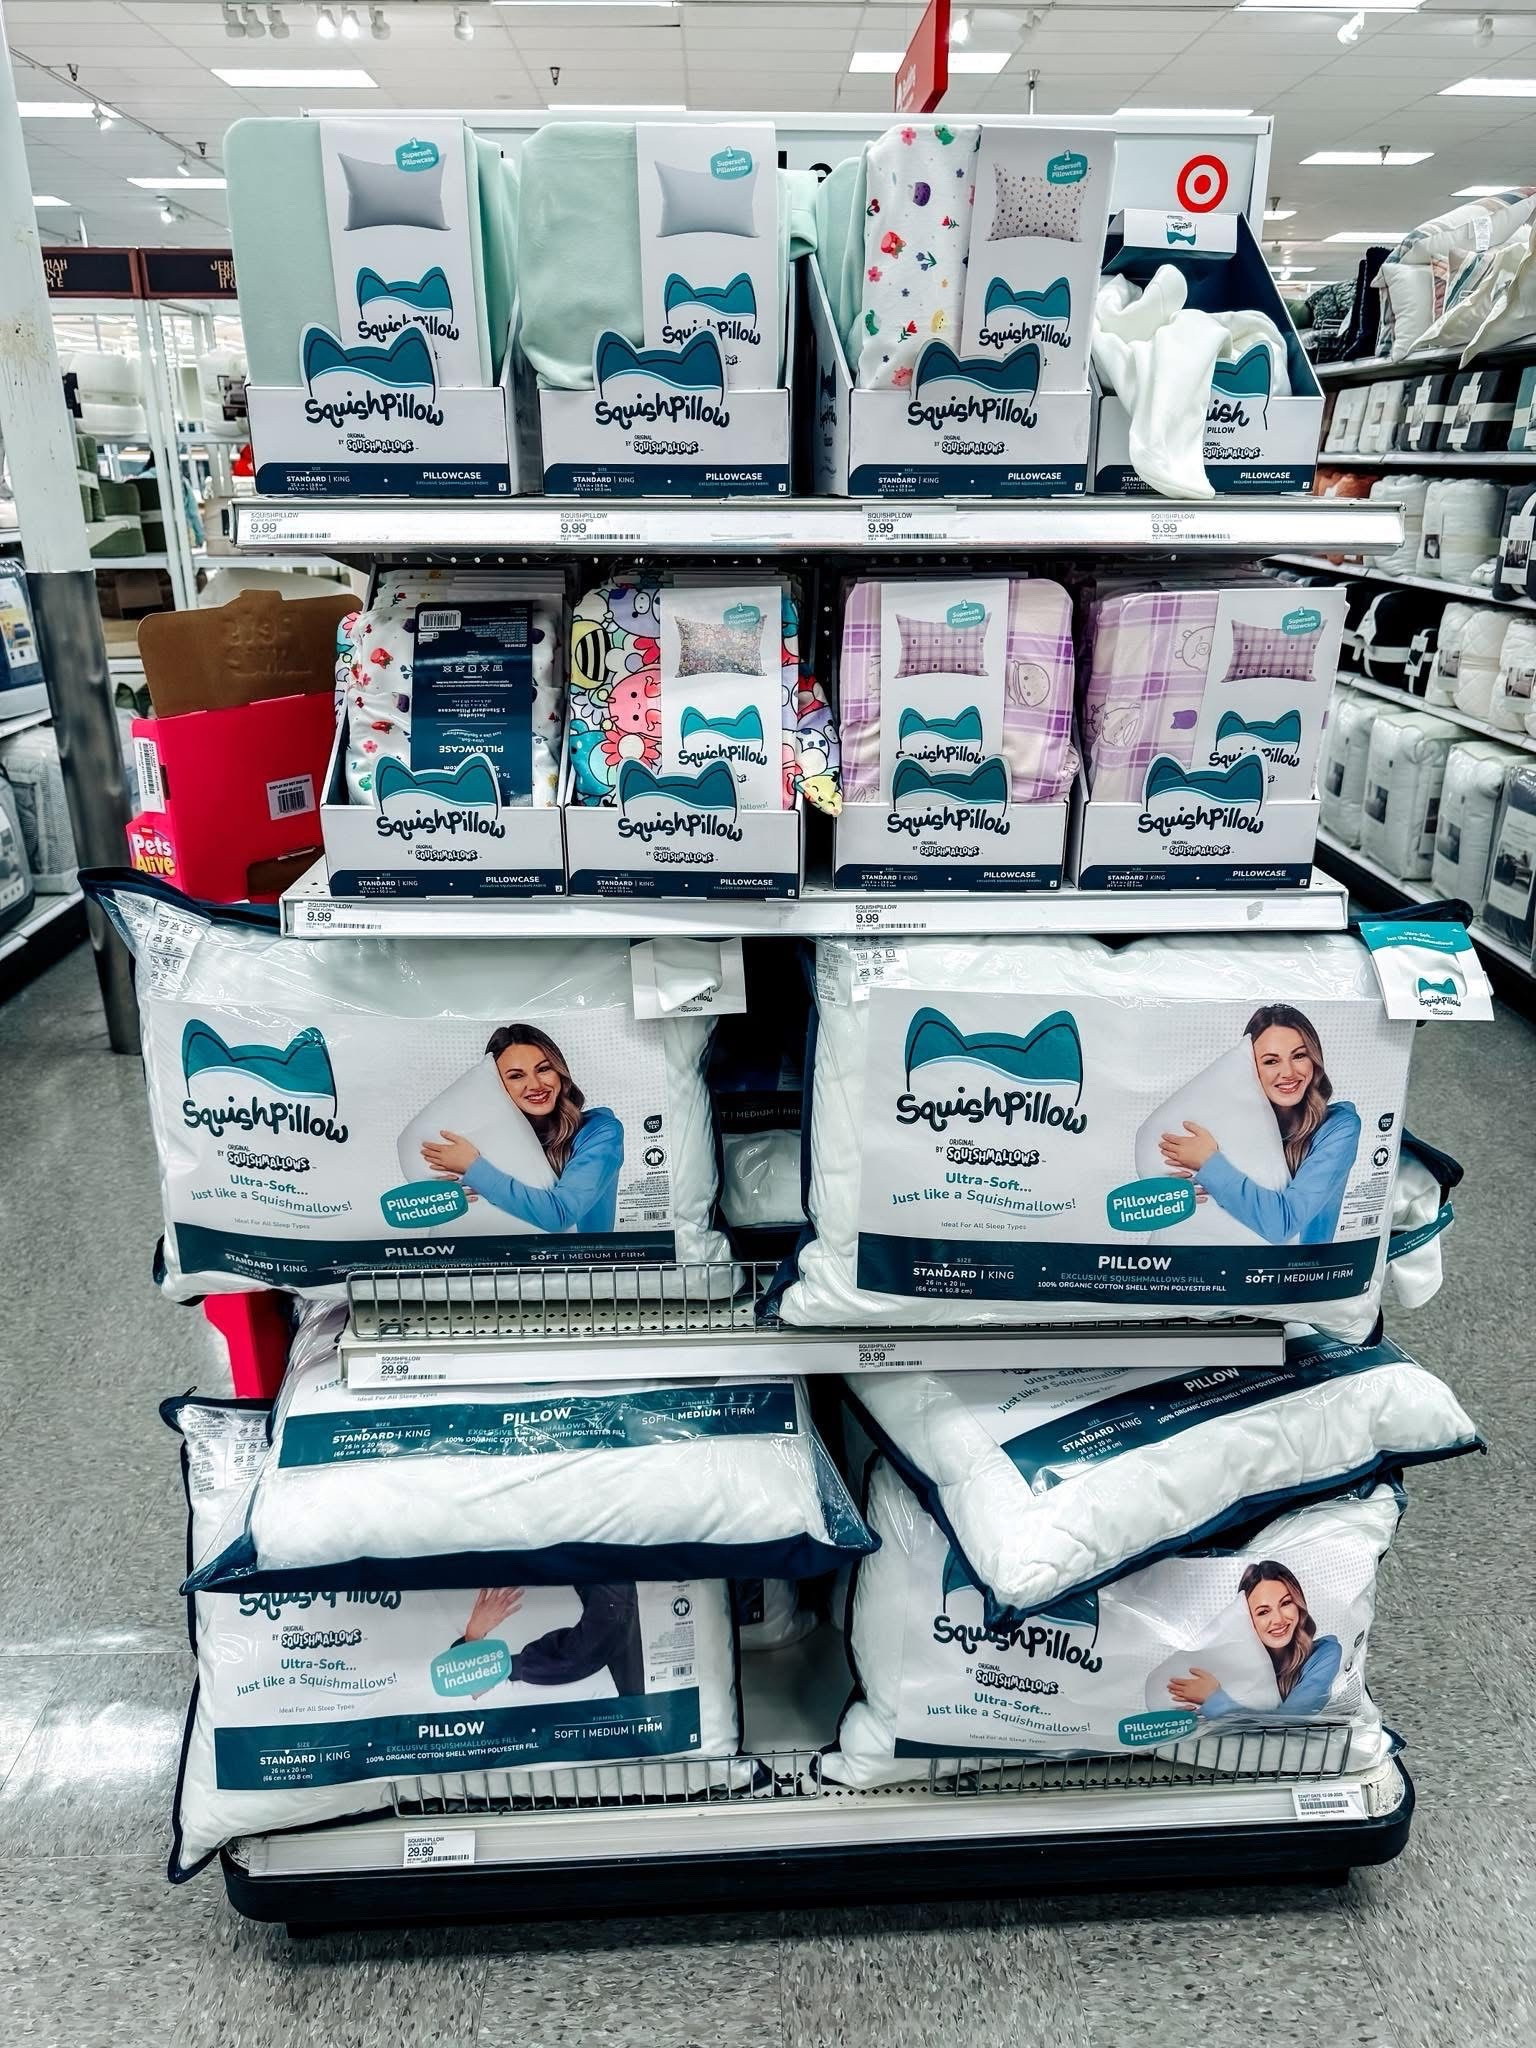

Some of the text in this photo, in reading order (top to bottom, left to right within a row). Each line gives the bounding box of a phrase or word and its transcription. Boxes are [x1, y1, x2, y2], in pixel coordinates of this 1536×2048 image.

[1064, 150, 1071, 162] 1
[1051, 168, 1084, 179] Pillowcase
[978, 322, 1072, 349] SquishPillow
[304, 390, 444, 429] SquishPillow
[594, 392, 730, 430] SquishPillow
[907, 395, 1038, 430] SquishPillow
[1206, 426, 1236, 434] PILLOW
[346, 439, 415, 454] SQUISHMALLOWS
[633, 440, 700, 455] SQUISHMALLOWS
[941, 441, 1005, 455] SQUISHMALLOWS
[286, 475, 350, 483] STANDARD KING
[422, 471, 482, 480] PILLOWCASE
[705, 472, 763, 481] PILLOWCASE
[1007, 472, 1062, 481] PILLOWCASE
[1240, 471, 1291, 479] PILLOWCASE
[250, 523, 278, 533] 9.99
[560, 523, 587, 534] 9.99
[868, 523, 894, 534] 9.99
[1151, 523, 1178, 533] 9.99
[439, 745, 504, 753] PILLOWCASE
[375, 809, 506, 841] SquishPillow
[617, 811, 744, 843] SquishPillow
[886, 806, 1011, 837] SquishPillow
[1137, 806, 1264, 837] SquishPillow
[131, 833, 173, 857] Pets
[919, 845, 980, 857] SQUISHMALLOWS
[1169, 845, 1231, 857] SQUISHMALLOWS
[415, 850, 479, 861] SQUISHMALLOWS
[653, 851, 714, 863] SQUISHMALLOWS
[135, 853, 176, 877] Alive
[1232, 869, 1287, 877] PILLOWCASE
[720, 878, 774, 886] PILLOWCASE
[983, 871, 1037, 879] PILLOWCASE
[307, 911, 332, 922] 9.99
[855, 913, 880, 924] 9.99
[895, 1086, 1088, 1134] SquishPillow
[182, 1096, 349, 1144] SquishPillow
[948, 1138, 975, 1147] ORIGINAL
[227, 1150, 311, 1173] SQUISHMALLOWS
[935, 1145, 1040, 1167] BY SQUISHMALLOWS
[230, 1174, 309, 1197] Ultra-Soft...
[945, 1172, 1032, 1193] Ultra-Soft...
[191, 1189, 353, 1213] Just a Squishmallows!
[386, 1188, 460, 1212] Pillowcase
[891, 1188, 1077, 1213] Just like a Squishmallows!
[1112, 1189, 1190, 1211] Pillowcase
[395, 1200, 458, 1222] Included!
[1120, 1201, 1185, 1223] Included!
[960, 1221, 973, 1229] For
[973, 1221, 984, 1229] All
[985, 1221, 1005, 1231] Sleep
[1006, 1223, 1027, 1231] Types
[385, 1244, 456, 1257] PILLOW
[530, 1250, 646, 1262] SOFT MEDIUM FIRM
[224, 1252, 274, 1271] STANDARD
[282, 1264, 308, 1273] KING
[1097, 1255, 1172, 1271] PILLOW
[912, 1267, 1015, 1280] STANDARD KING
[1060, 1272, 1205, 1284] EXCLUSIVE SQUISHMALLOWS FILL
[1245, 1269, 1354, 1285] SOFT MEDIUM FIRM
[1058, 1281, 1093, 1290] ORGANIC
[1094, 1282, 1124, 1290] COTTON
[1171, 1284, 1211, 1292] POLYESTER
[858, 1351, 886, 1362] 29.99
[380, 1364, 409, 1375] 29.99
[1183, 1367, 1241, 1393] PILLOW
[502, 1406, 572, 1426] PILLOW
[641, 1407, 755, 1425] SOFT MEDIUM FIRM
[332, 1428, 432, 1444] STANDARD KING
[1062, 1417, 1142, 1453] STANDARD KING
[272, 1628, 363, 1650] BY SQUISHMALLOWS
[280, 1657, 358, 1672] Ultra-Soft...
[436, 1649, 504, 1678] Pillowcase
[235, 1672, 398, 1697] Just like a Squishmallows!
[443, 1664, 502, 1690] Included!
[975, 1668, 1060, 1695] SQUISHMALLOWS
[973, 1692, 1052, 1717] Ultra-Soft...
[926, 1703, 1091, 1734] Just like a Squishmallows!
[1123, 1716, 1193, 1734] Pillowcase
[417, 1720, 486, 1739] PILLOW
[553, 1722, 664, 1739] SOFT MEDIUM FIRM
[1130, 1725, 1189, 1742] Included!
[259, 1750, 351, 1765] STANDARD KING
[365, 1741, 540, 1764] 100% ORGANIC COTTON SHELL WITH POLYESTER FILL
[407, 1846, 434, 1857] 29.99
